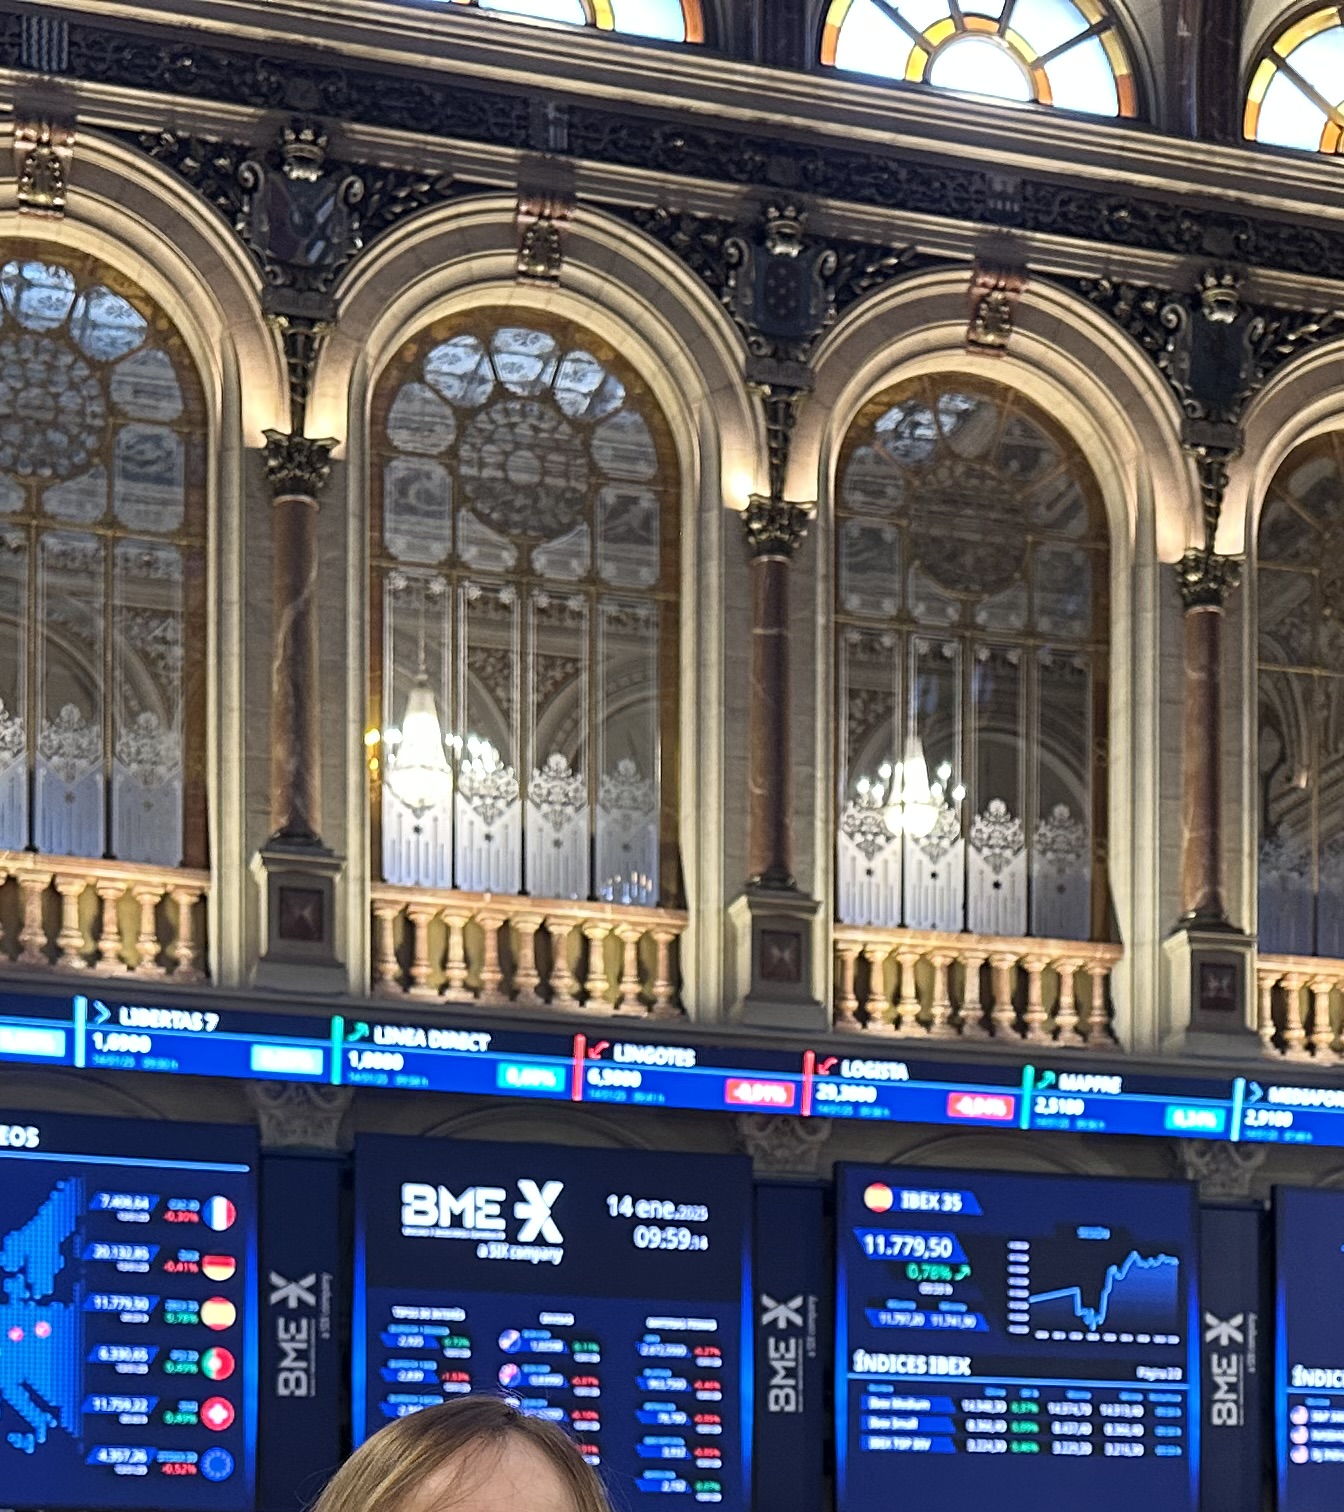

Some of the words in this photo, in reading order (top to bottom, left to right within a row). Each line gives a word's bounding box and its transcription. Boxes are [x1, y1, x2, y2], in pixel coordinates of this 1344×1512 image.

[119, 1005, 204, 1032] LIBERTAS
[205, 1013, 220, 1032] 7
[373, 1025, 427, 1048] LINEA
[428, 1029, 491, 1052] DIRECT
[613, 1043, 696, 1068] LINGOTES
[840, 1058, 910, 1082] LOGISTA
[1058, 1072, 1123, 1095] MAPFRE
[400, 1182, 506, 1230] BME
[606, 1194, 633, 1217] 14
[900, 1190, 940, 1210] IBEX
[940, 1192, 963, 1212] 35
[510, 1245, 564, 1265] company
[863, 1233, 953, 1260] 11.779,50
[906, 1262, 953, 1282] 0,78%
[277, 1317, 308, 1397] BME
[853, 1349, 928, 1375] ÍNDICES
[928, 1355, 972, 1376] IBEX
[768, 1337, 796, 1412] BME
[1211, 1353, 1238, 1426] BME
